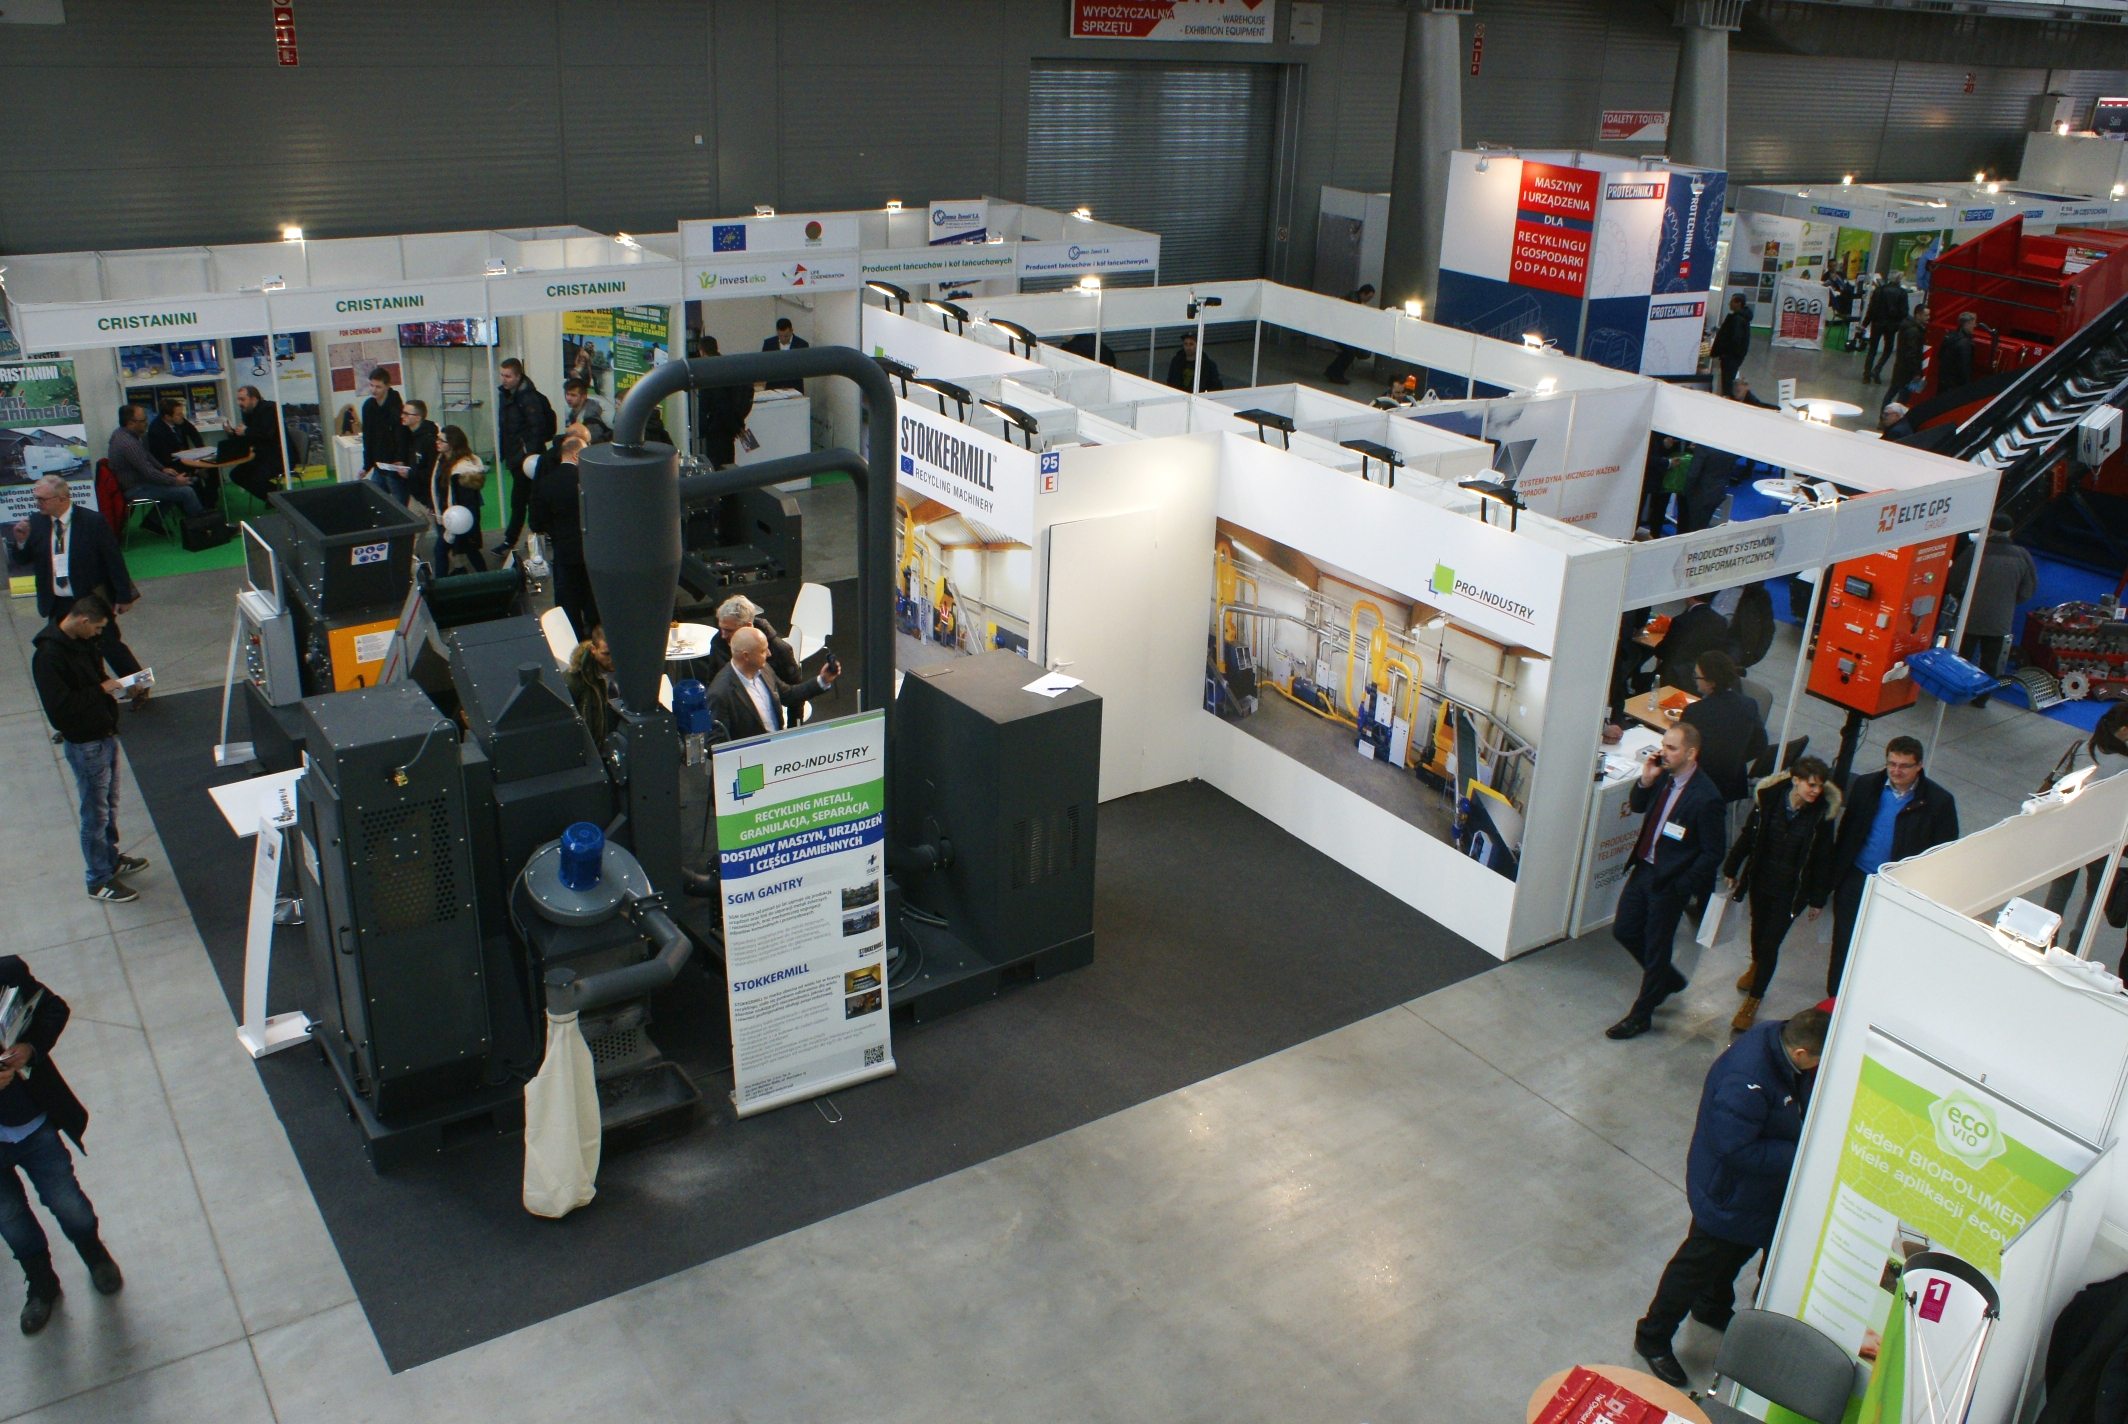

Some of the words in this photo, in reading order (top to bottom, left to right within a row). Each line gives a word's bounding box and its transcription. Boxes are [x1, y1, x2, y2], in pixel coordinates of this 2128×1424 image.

[1082, 6, 1175, 20] WYPOŻYCZALNIA
[1222, 15, 1266, 25] WAREHOUSE
[1082, 21, 1132, 36] SPRZĘTU
[1184, 26, 1224, 36] EXHIBITION
[1226, 27, 1266, 37] EQUIPMENT
[1603, 114, 1633, 124] TOALETY
[1534, 176, 1583, 194] MASZYNY
[1607, 184, 1654, 199] PROTECHNIKA
[1528, 192, 1591, 211] URZĄDZENIA
[1543, 214, 1564, 227] DLA
[1682, 193, 1701, 261] PROTECHNIKA
[1518, 230, 1586, 252] RECYKLINGU
[861, 264, 901, 273] Producent
[902, 260, 943, 271] łańcuchów
[948, 259, 961, 267] kół
[961, 257, 1013, 267] łańcuchowych
[1521, 246, 1584, 268] GOSPODARKI
[719, 273, 767, 285] investeko
[1514, 260, 1583, 283] ODPADAMI
[546, 280, 626, 298] CRISTANINI
[335, 294, 425, 313] CRISTANINI
[1651, 304, 1694, 319] PROTECHNIKA
[97, 311, 198, 331] CRISTANINI
[0, 365, 60, 383] RISTANINI
[901, 415, 994, 492] STOKKERMILL
[1042, 455, 1059, 471] 95
[1045, 475, 1054, 491] E
[1519, 477, 1544, 488] SYSTEM
[1595, 465, 1620, 476] WAŻENIA
[915, 467, 951, 494] RECYCLING
[953, 485, 994, 514] MACHINERY
[1584, 512, 1598, 520] RFID
[1897, 502, 1927, 524] ELTE
[1928, 496, 1952, 517] GPS
[1924, 517, 1947, 531] GROUP
[1687, 544, 1734, 564] PRODUCENT
[1734, 535, 1777, 554] SYSTEMÓW
[1685, 549, 1775, 578] TELEINFORMATYCZNYCH
[1454, 579, 1535, 620] PRO-INDUSTRY
[774, 745, 870, 777] PRO-INDUSTRY
[755, 800, 811, 824] RECYKLING
[813, 791, 854, 809] METALI,
[740, 815, 810, 842] GRANULACJA,
[812, 801, 870, 823] SEPARACJA
[721, 842, 775, 864] DOSTAWY
[777, 830, 827, 852] MASZYN,
[829, 812, 883, 838] URZĄDZEŃ
[1600, 829, 1640, 851] PRODUCEN
[750, 862, 755, 873] I
[756, 851, 790, 872] CZĘŚCI
[792, 835, 863, 862] ZAMIENNYCH
[727, 891, 755, 905] SGM
[758, 876, 804, 899] GANTRY
[733, 963, 810, 993] STOKKERMILL
[1947, 1105, 1990, 1140] eco
[1952, 1124, 1978, 1148] VIO
[1849, 1141, 1890, 1174] wiele
[1894, 1168, 1966, 1220] aplikacji
[1854, 1119, 1905, 1156] Jeden
[1908, 1149, 2027, 1232] BIOPOLIMER
[1930, 1282, 1946, 1302] 1
